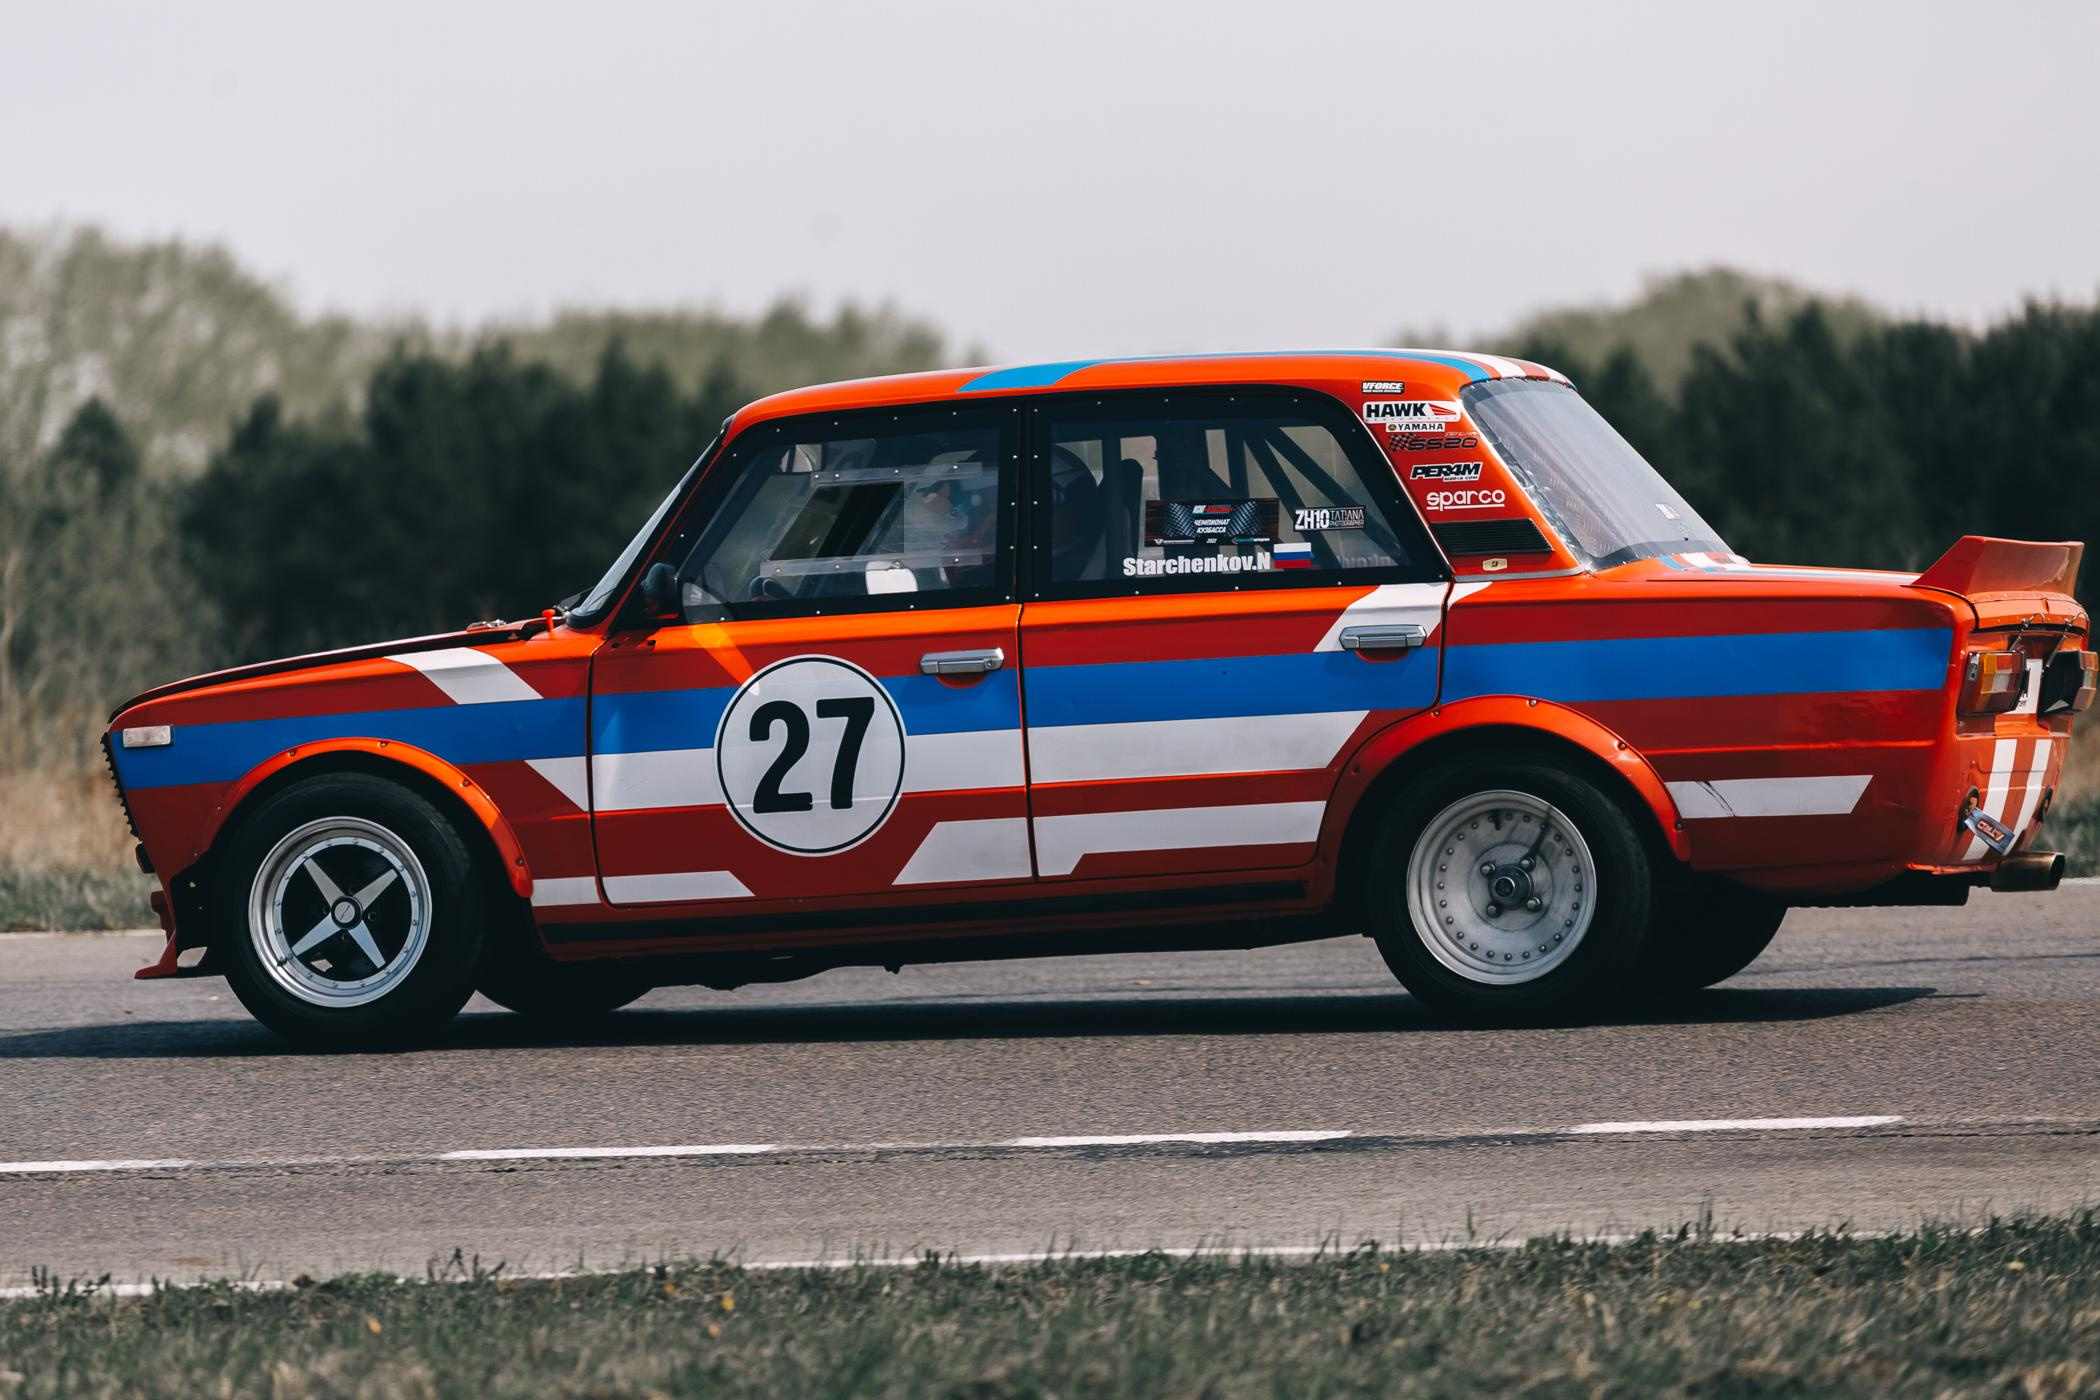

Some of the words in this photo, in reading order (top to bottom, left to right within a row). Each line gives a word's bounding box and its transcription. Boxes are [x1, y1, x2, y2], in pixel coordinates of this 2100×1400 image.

[1362, 382, 1404, 390] VFORCE
[1366, 403, 1426, 418] HAWK
[1398, 423, 1444, 431] YAMAHA
[1407, 437, 1478, 450] SS20
[1426, 489, 1506, 511] sparco
[1295, 509, 1330, 530] ZH10
[1330, 509, 1364, 521] TATIANA
[1122, 552, 1271, 576] Starchenkov.N
[749, 697, 875, 814] 27
